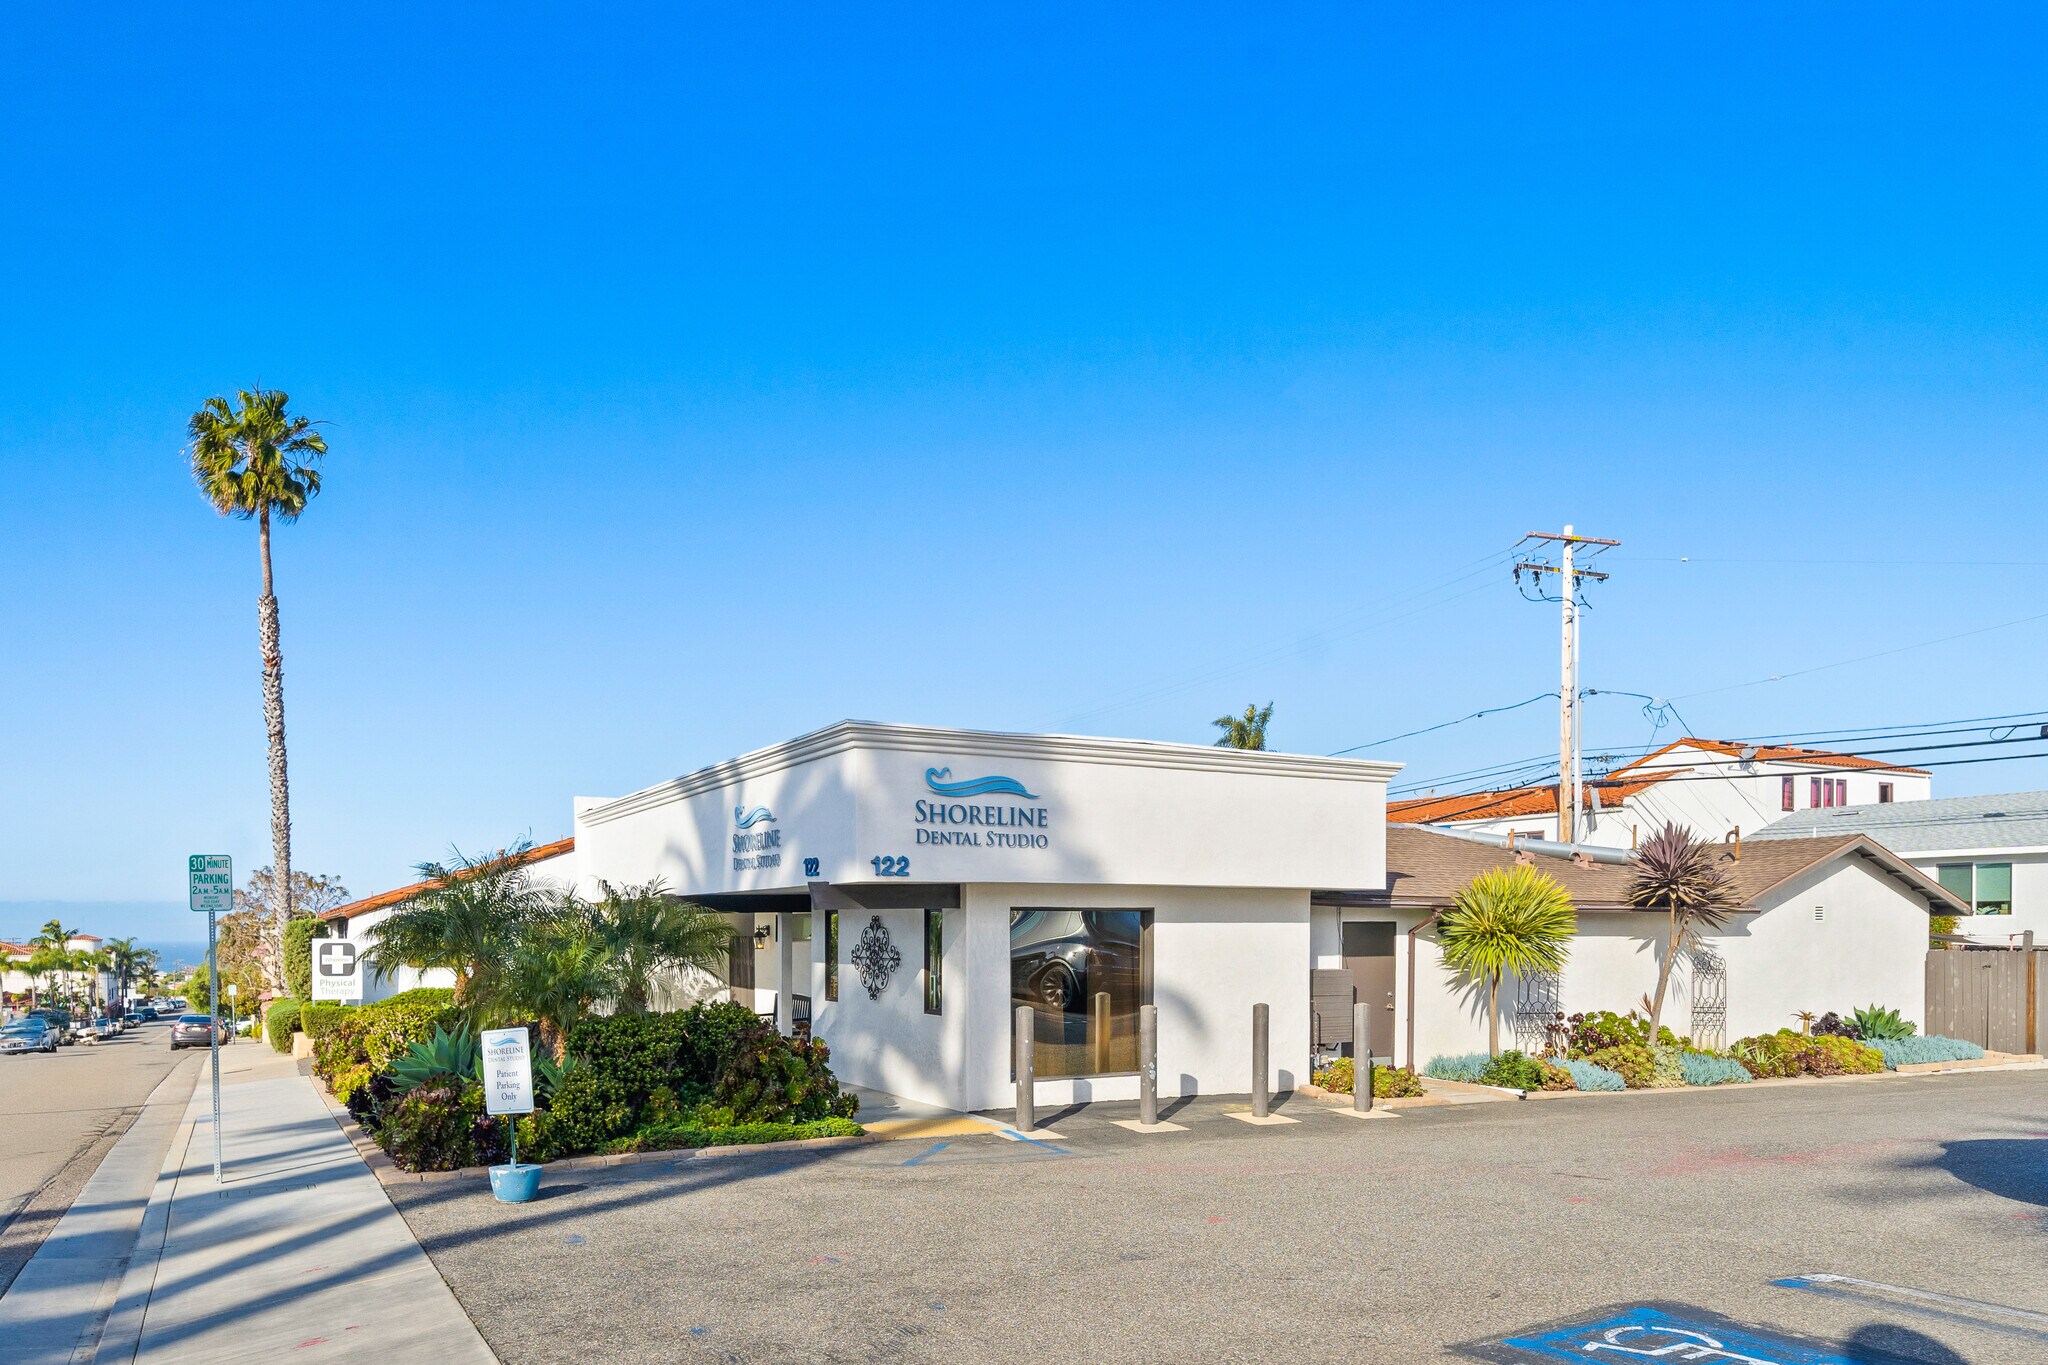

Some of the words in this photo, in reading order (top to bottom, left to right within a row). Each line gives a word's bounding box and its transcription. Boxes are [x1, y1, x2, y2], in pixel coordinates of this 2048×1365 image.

[915, 800, 1048, 827] SHORELINE
[916, 828, 981, 846] DENTAL
[986, 831, 1048, 849] STUDIO
[191, 857, 204, 870] 30
[207, 860, 229, 868] MINUTE
[803, 857, 820, 876] 122
[870, 855, 910, 876] 122
[193, 874, 228, 884] PARKING
[320, 979, 355, 988] Physical
[320, 987, 354, 996] Therapy
[487, 1046, 524, 1056] SHORELINE
[496, 1070, 519, 1078] Patient
[496, 1081, 521, 1090] Parking
[501, 1093, 517, 1102] Only
